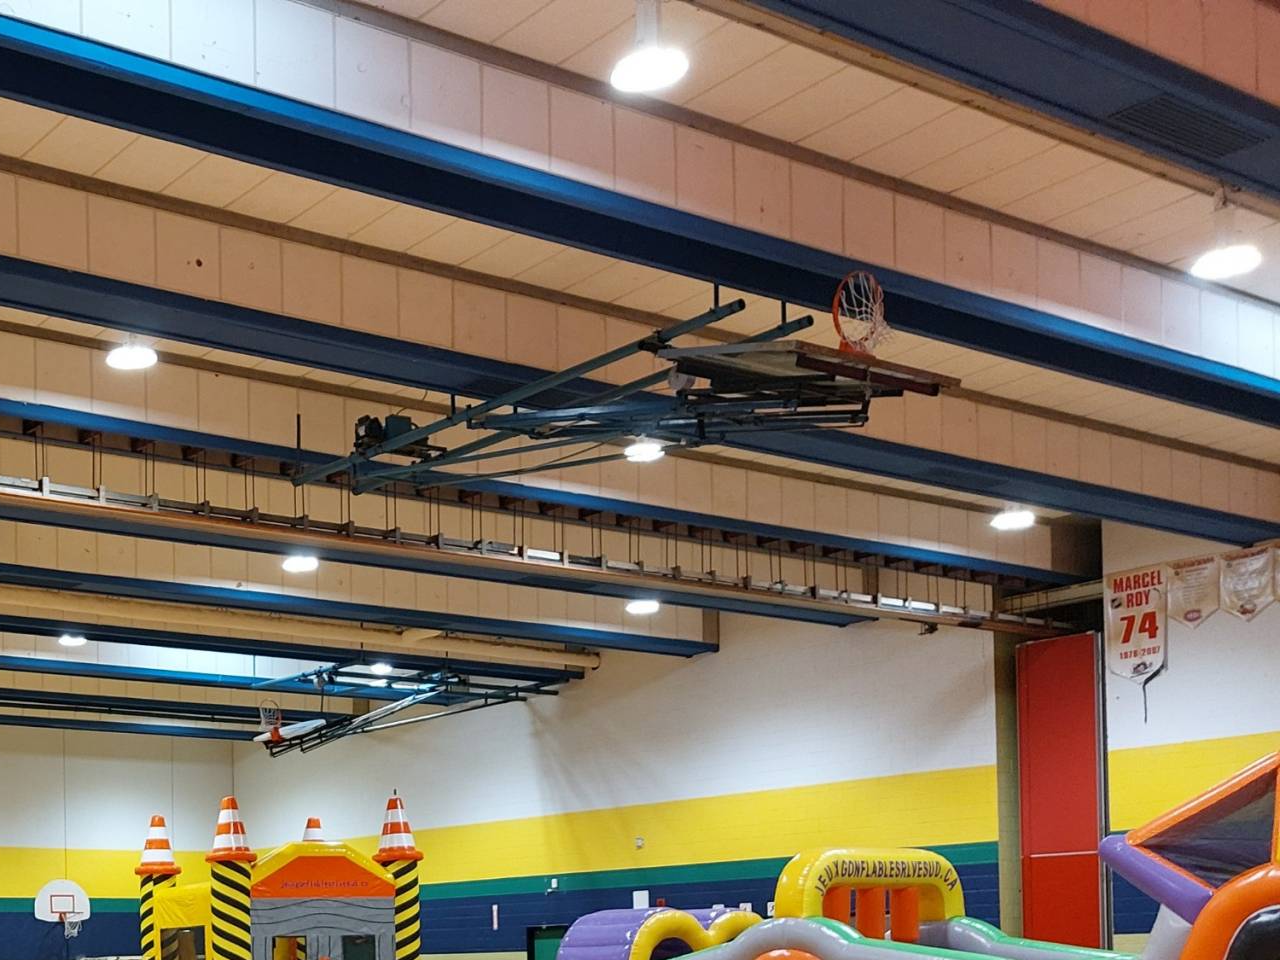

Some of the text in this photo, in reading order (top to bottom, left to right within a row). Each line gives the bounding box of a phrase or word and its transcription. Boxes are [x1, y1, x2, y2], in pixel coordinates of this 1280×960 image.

[1113, 569, 1163, 593] MARCEL
[1126, 590, 1150, 608] ROY
[1120, 611, 1159, 643] 74
